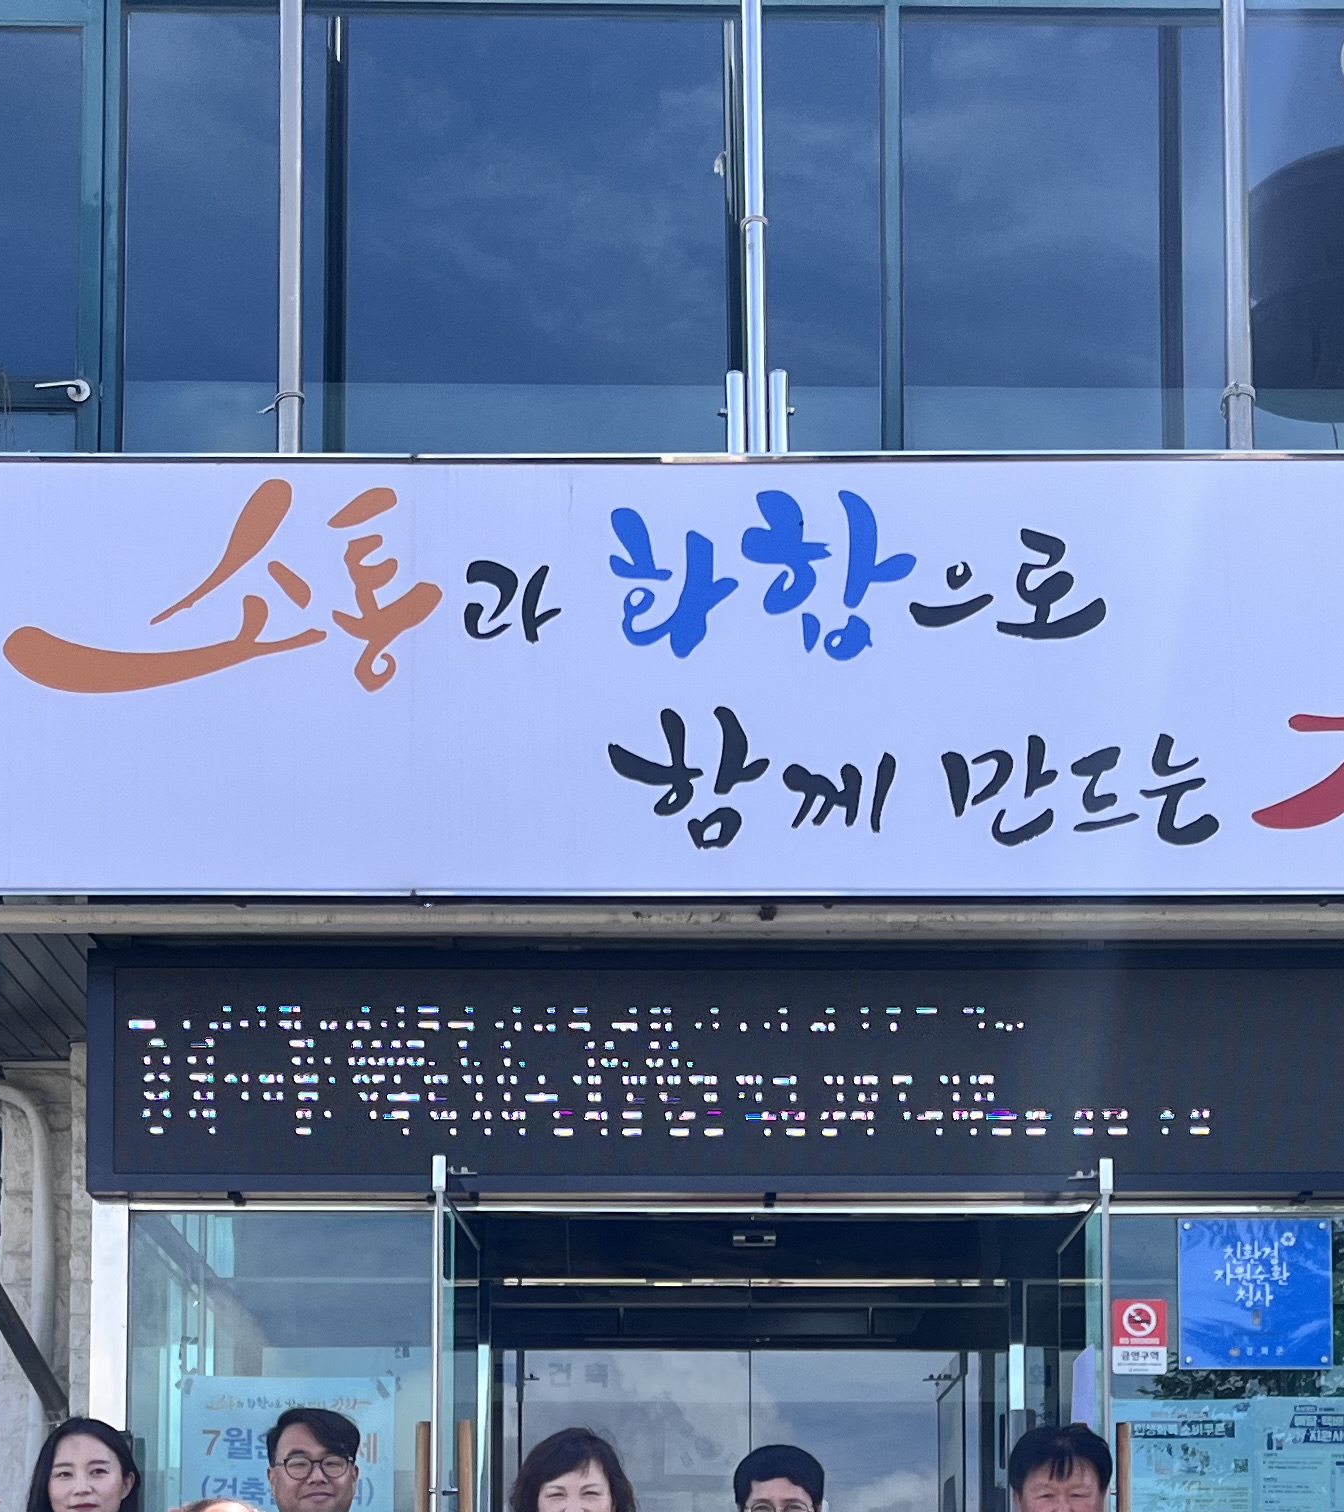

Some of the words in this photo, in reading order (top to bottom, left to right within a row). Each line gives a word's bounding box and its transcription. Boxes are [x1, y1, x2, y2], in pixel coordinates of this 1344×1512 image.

[608, 706, 890, 849] 함께
[948, 734, 1219, 847] 만드는
[1223, 1241, 1280, 1265] 친환경
[1213, 1262, 1291, 1286] 자원순환
[1235, 1284, 1274, 1307] 청사
